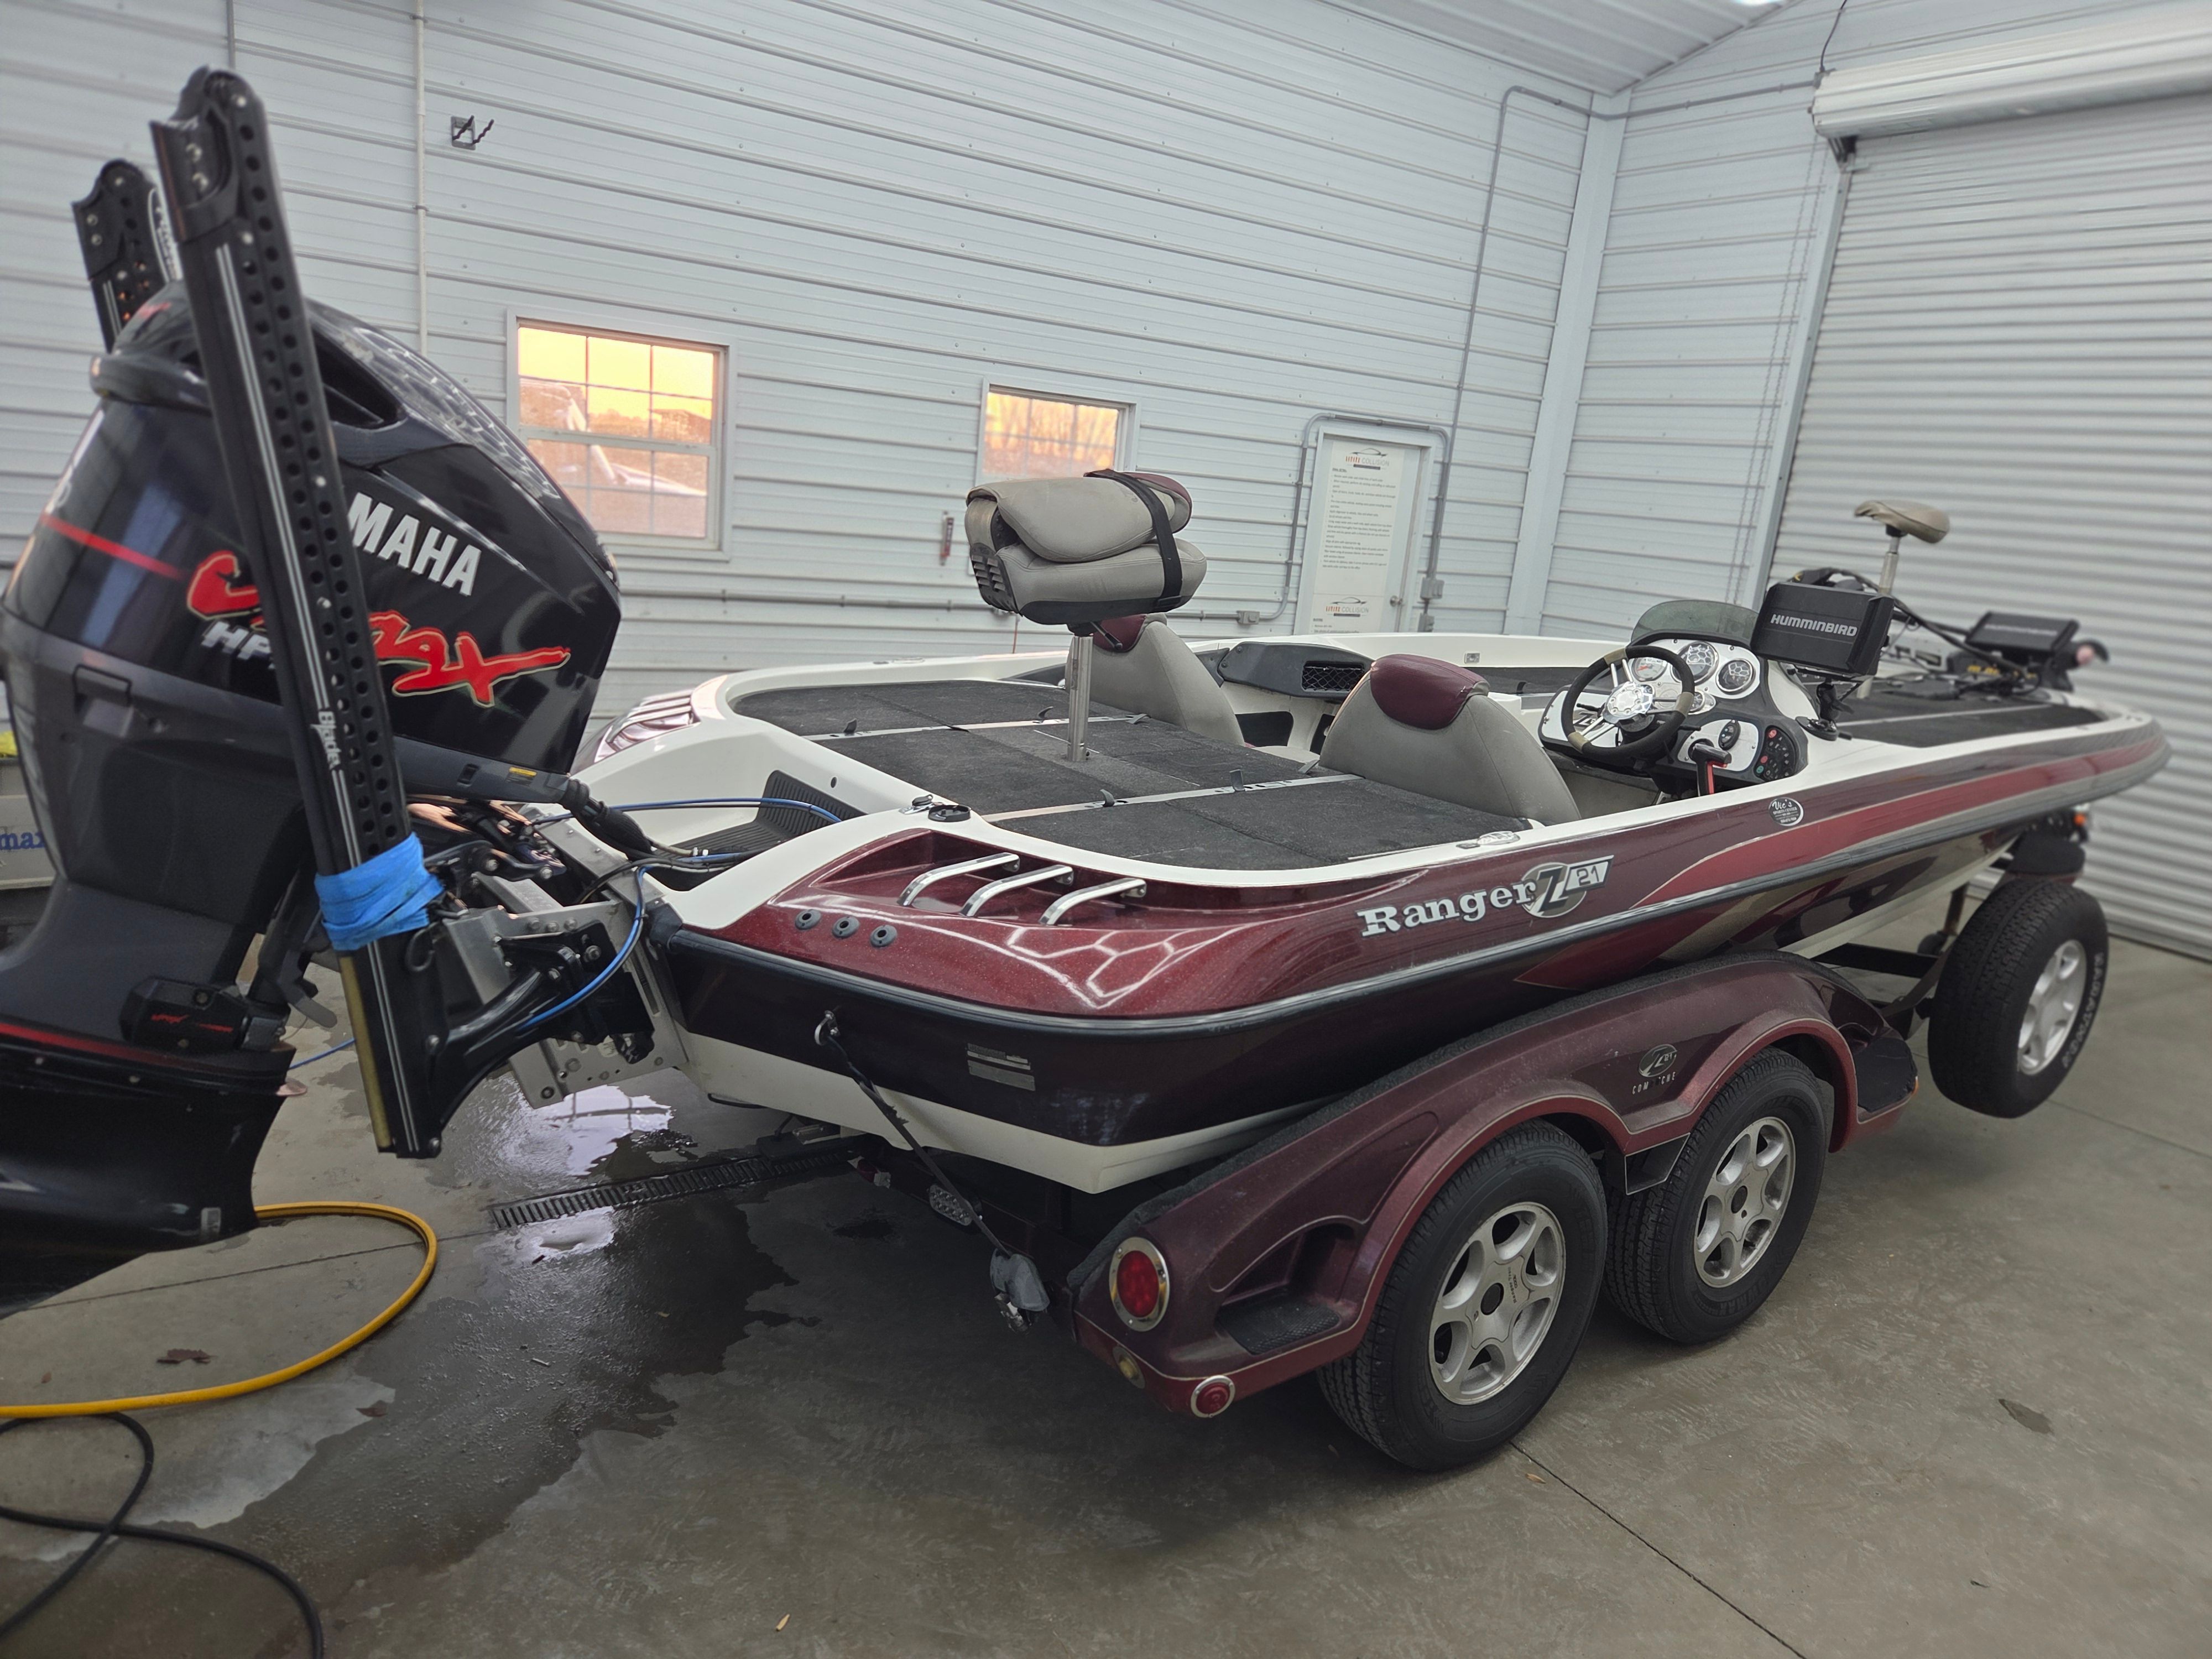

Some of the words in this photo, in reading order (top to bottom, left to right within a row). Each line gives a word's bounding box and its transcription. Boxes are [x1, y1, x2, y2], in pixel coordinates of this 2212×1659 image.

[347, 492, 482, 597] MAHA
[1771, 614, 1858, 637] HUMMINBIRD
[1772, 799, 1793, 810] Vic's
[1357, 880, 1536, 937] Ranger
[1632, 1071, 1676, 1095] COMCHE
